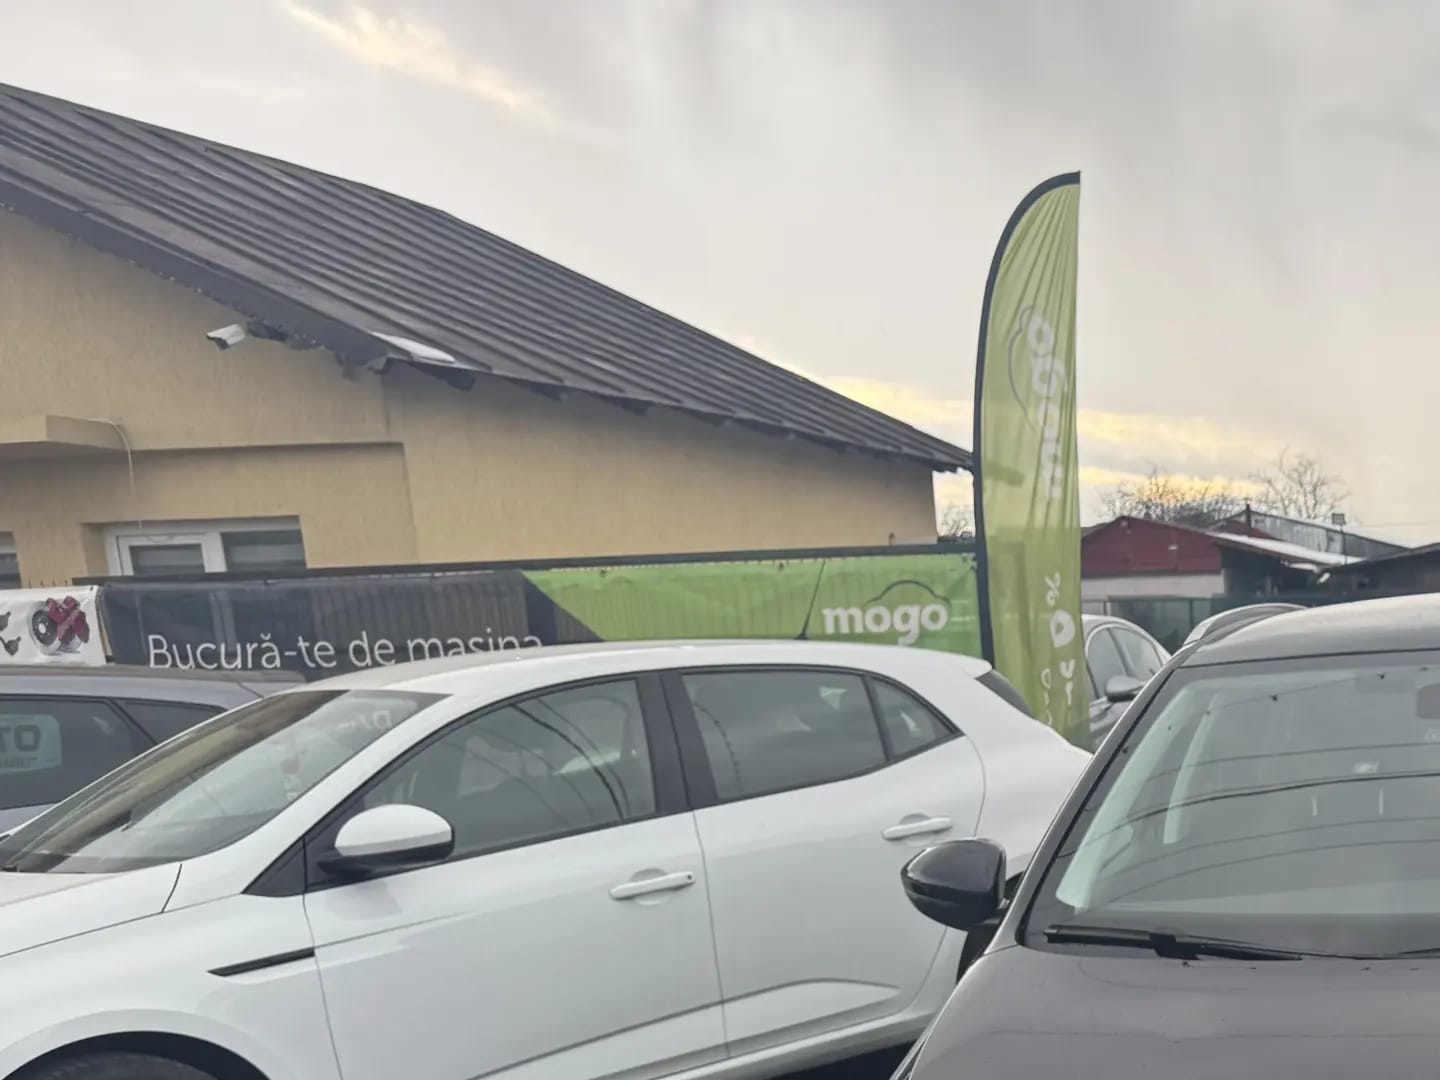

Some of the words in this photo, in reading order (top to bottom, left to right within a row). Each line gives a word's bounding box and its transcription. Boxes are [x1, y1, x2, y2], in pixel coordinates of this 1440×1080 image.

[822, 602, 949, 646] mogo
[147, 632, 337, 670] Bucură-te
[348, 629, 396, 668] de
